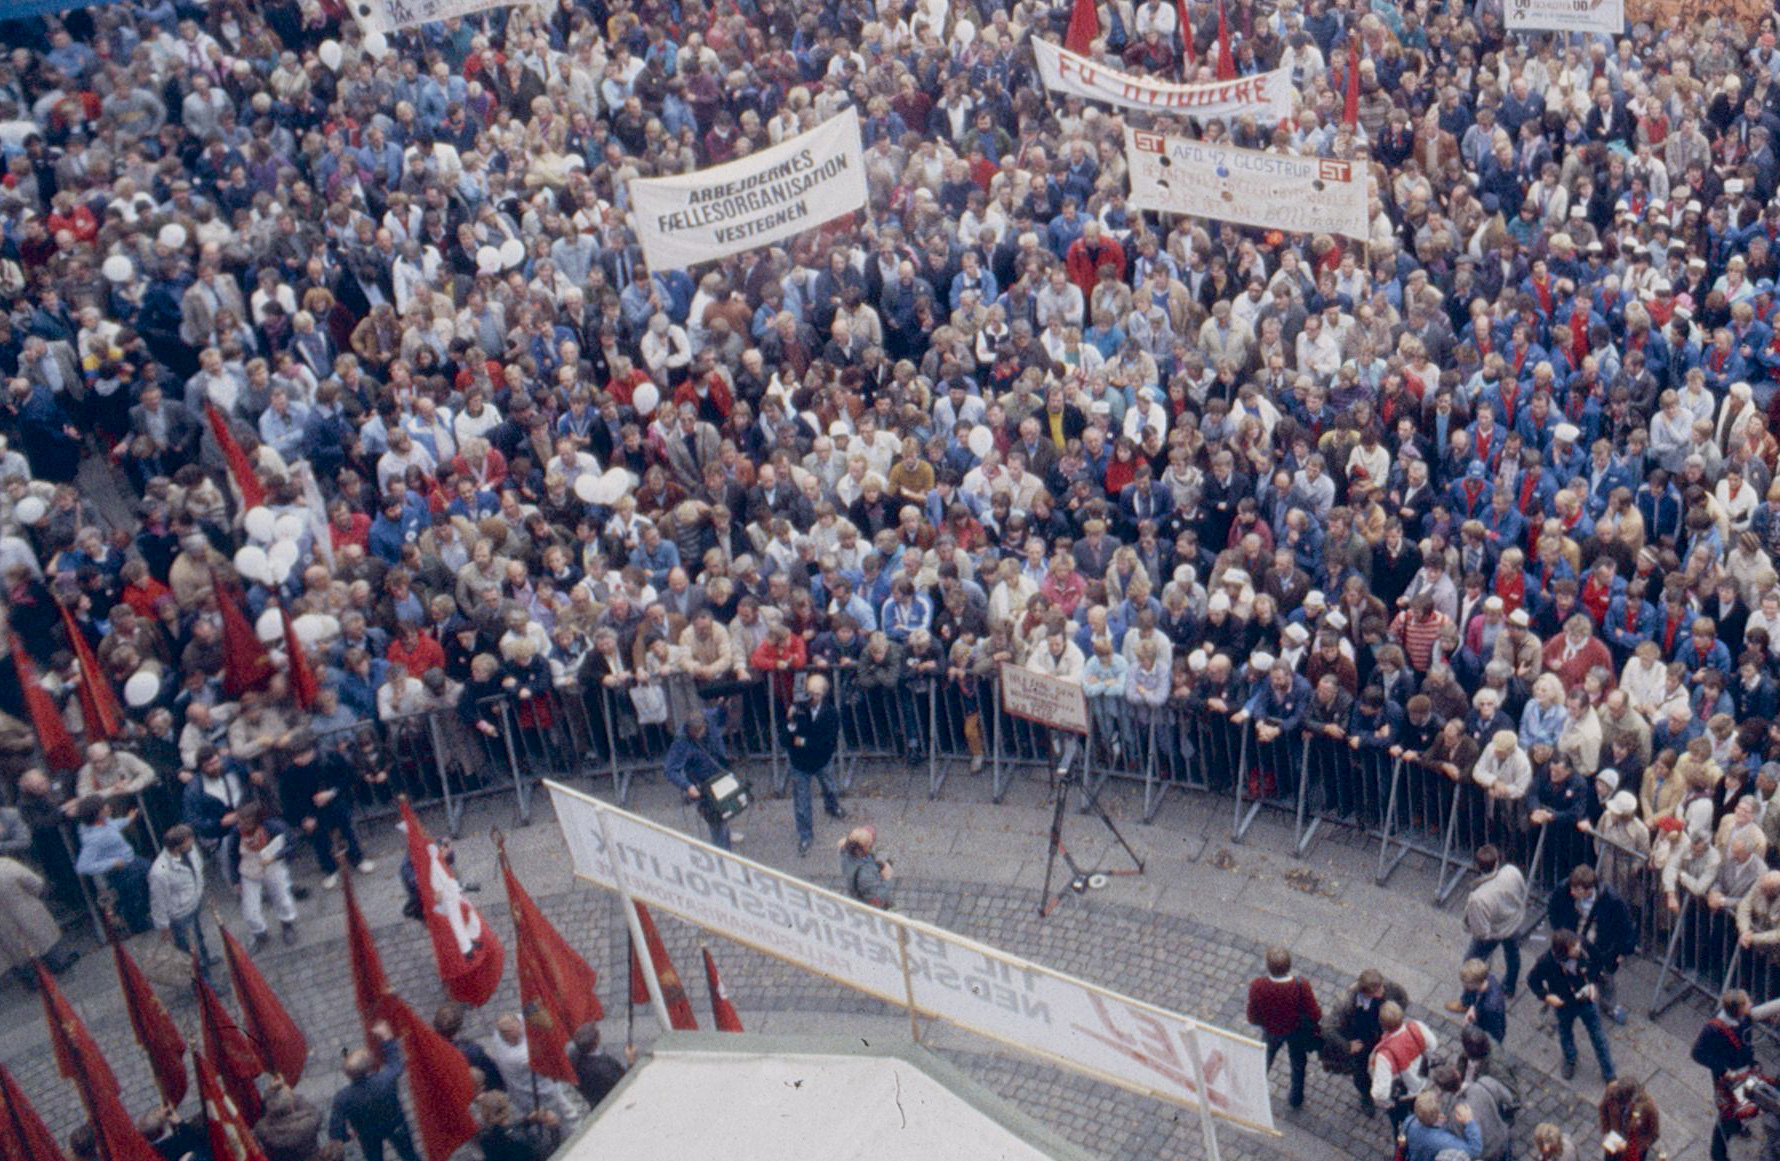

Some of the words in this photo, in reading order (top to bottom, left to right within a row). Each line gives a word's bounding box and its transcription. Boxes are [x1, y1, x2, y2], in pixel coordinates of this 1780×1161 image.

[1136, 132, 1164, 154] ST
[687, 148, 815, 206] ARBEJDERNES
[1206, 149, 1227, 167] 42
[1233, 150, 1312, 179] GLOSTRUP
[1321, 163, 1351, 182] ST
[657, 151, 849, 234] FÆLLESORGANISATION
[713, 199, 809, 244] VESTEGNEN
